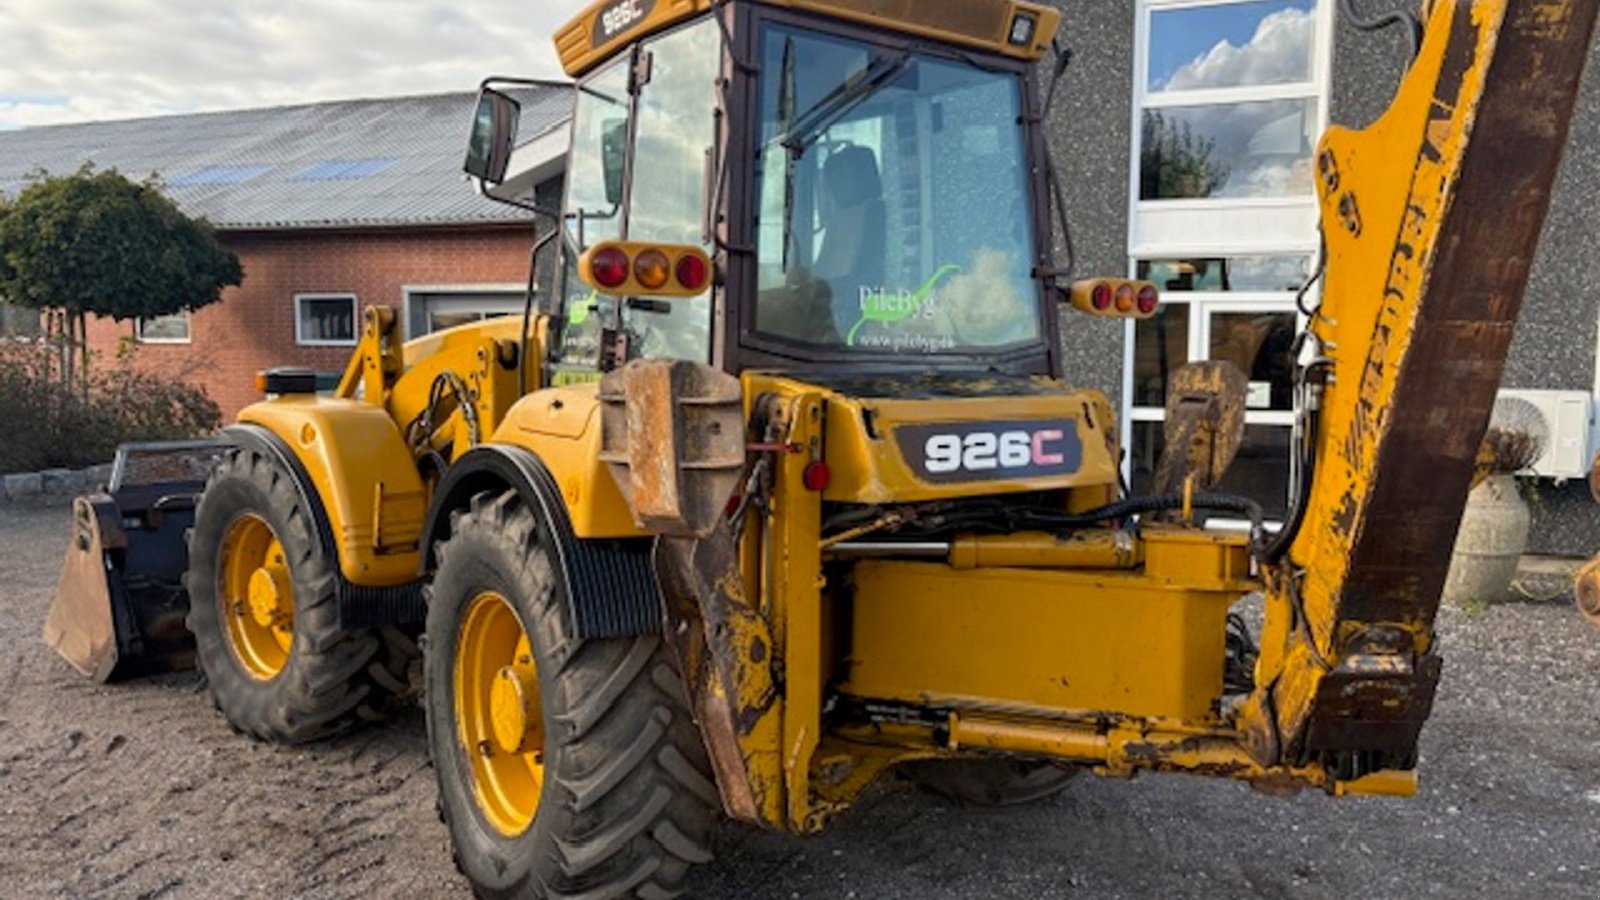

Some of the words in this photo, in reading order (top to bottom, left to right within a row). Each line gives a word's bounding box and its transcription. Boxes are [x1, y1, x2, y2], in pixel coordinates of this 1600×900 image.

[602, 0, 643, 35] 926C
[858, 286, 937, 320] PileByg
[924, 429, 1064, 474] 926C
